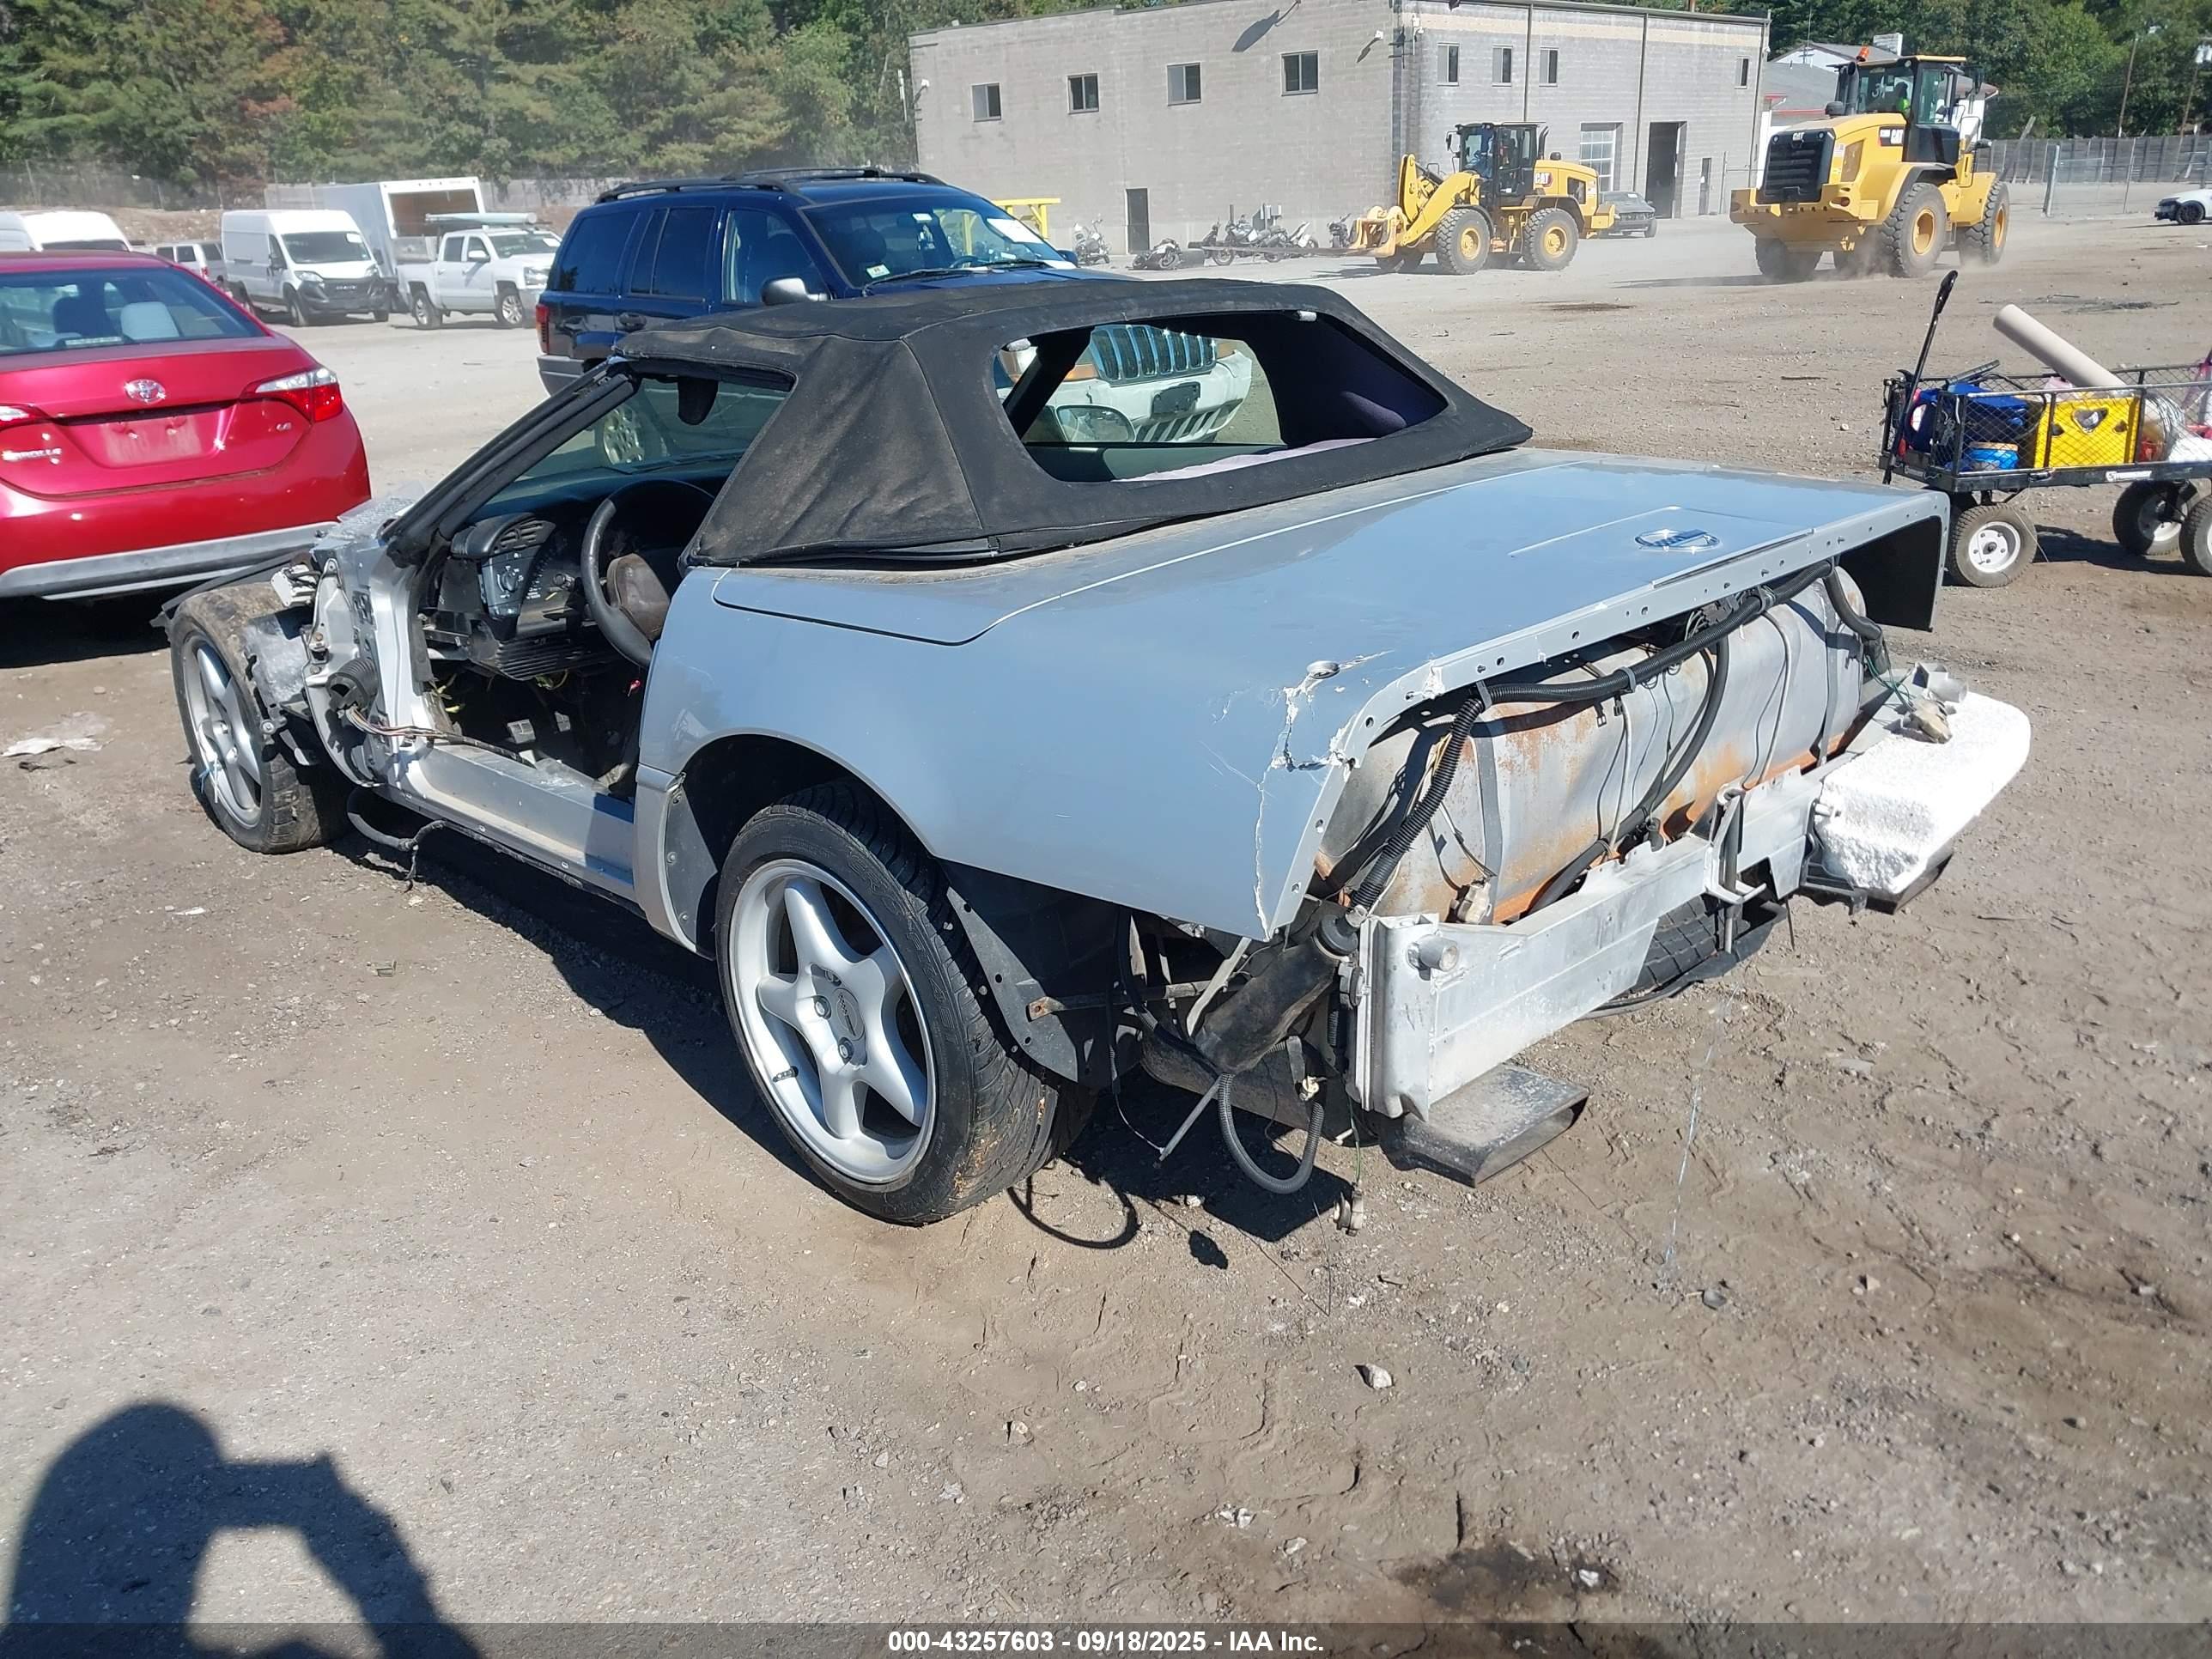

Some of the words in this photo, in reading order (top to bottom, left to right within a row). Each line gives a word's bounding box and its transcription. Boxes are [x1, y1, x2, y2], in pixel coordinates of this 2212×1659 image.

[1792, 131, 1805, 142] CAT
[1891, 129, 1904, 144] CAT
[1534, 172, 1550, 185] CAT
